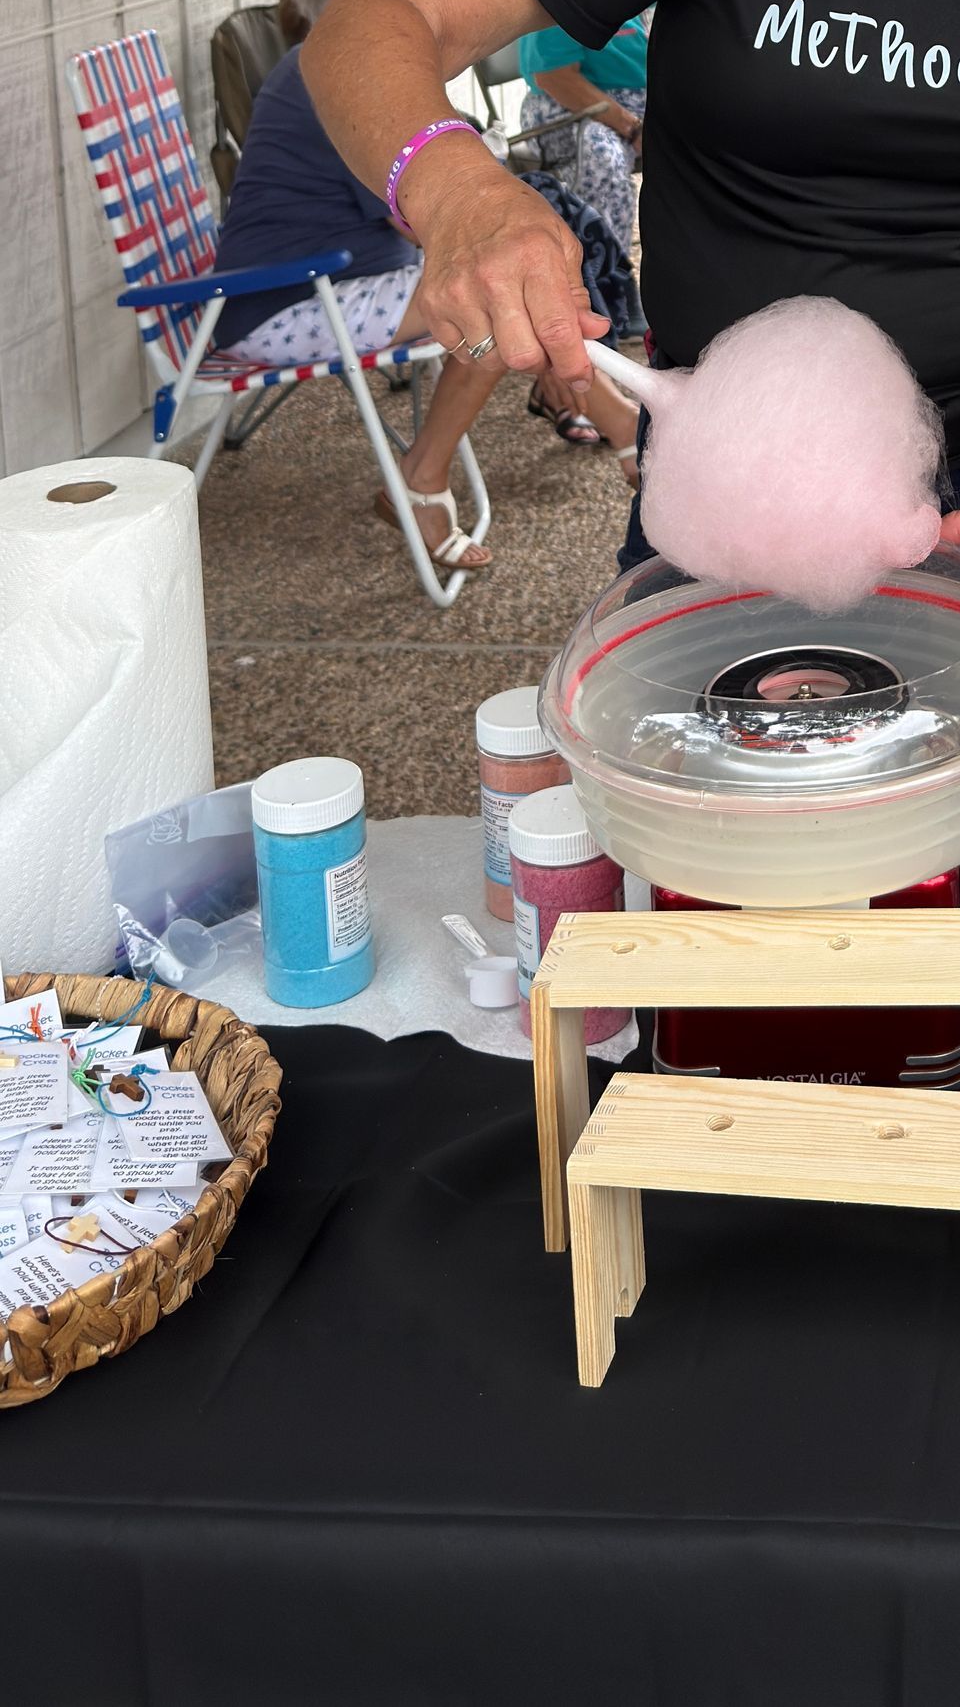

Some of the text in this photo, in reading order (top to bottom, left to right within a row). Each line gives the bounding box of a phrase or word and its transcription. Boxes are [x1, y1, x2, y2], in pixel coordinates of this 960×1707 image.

[10, 1014, 54, 1035] Pocet
[94, 1049, 128, 1059] ocket
[141, 1162, 157, 1170] He
[21, 1256, 49, 1284] wooden
[46, 1283, 61, 1296] cro
[35, 1255, 61, 1277] Here's
[12, 1266, 49, 1301] hold while
